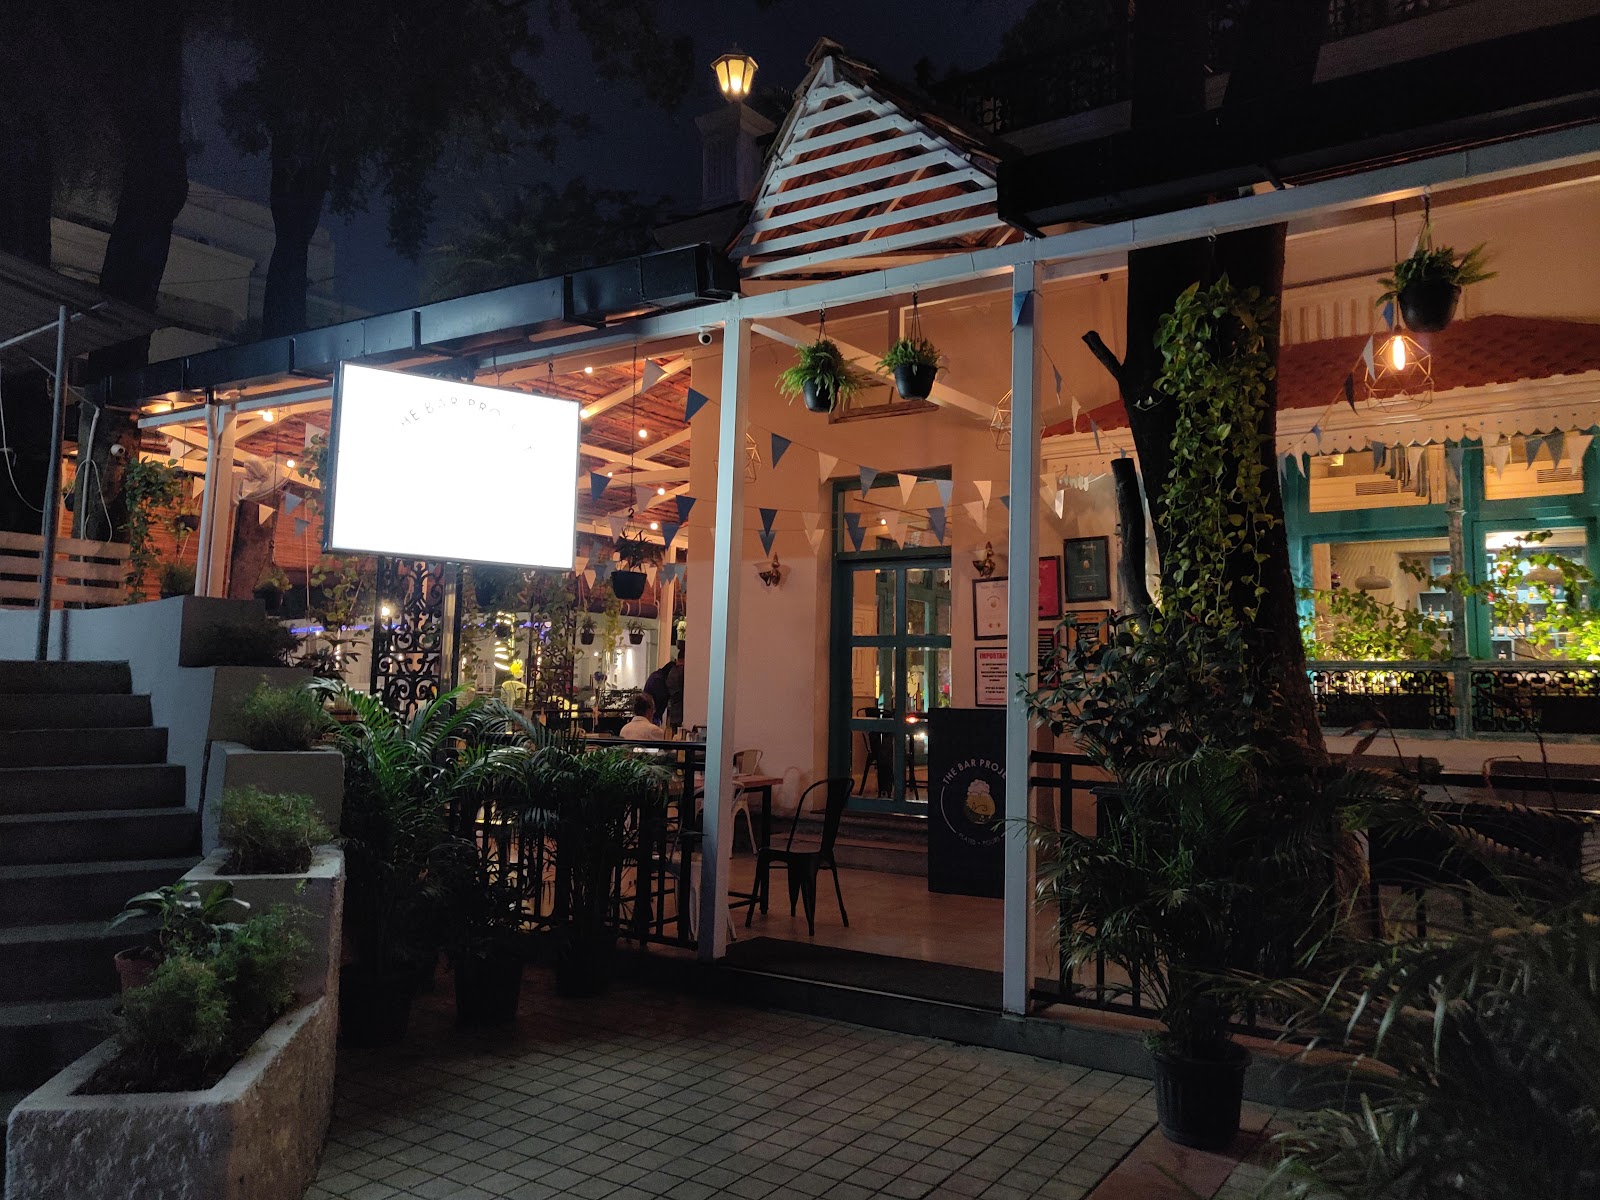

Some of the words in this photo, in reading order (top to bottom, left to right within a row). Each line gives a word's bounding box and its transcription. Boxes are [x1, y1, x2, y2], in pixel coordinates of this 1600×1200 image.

[943, 767, 958, 784] THE
[957, 758, 977, 772] BAR
[979, 759, 1006, 779] PROJE
